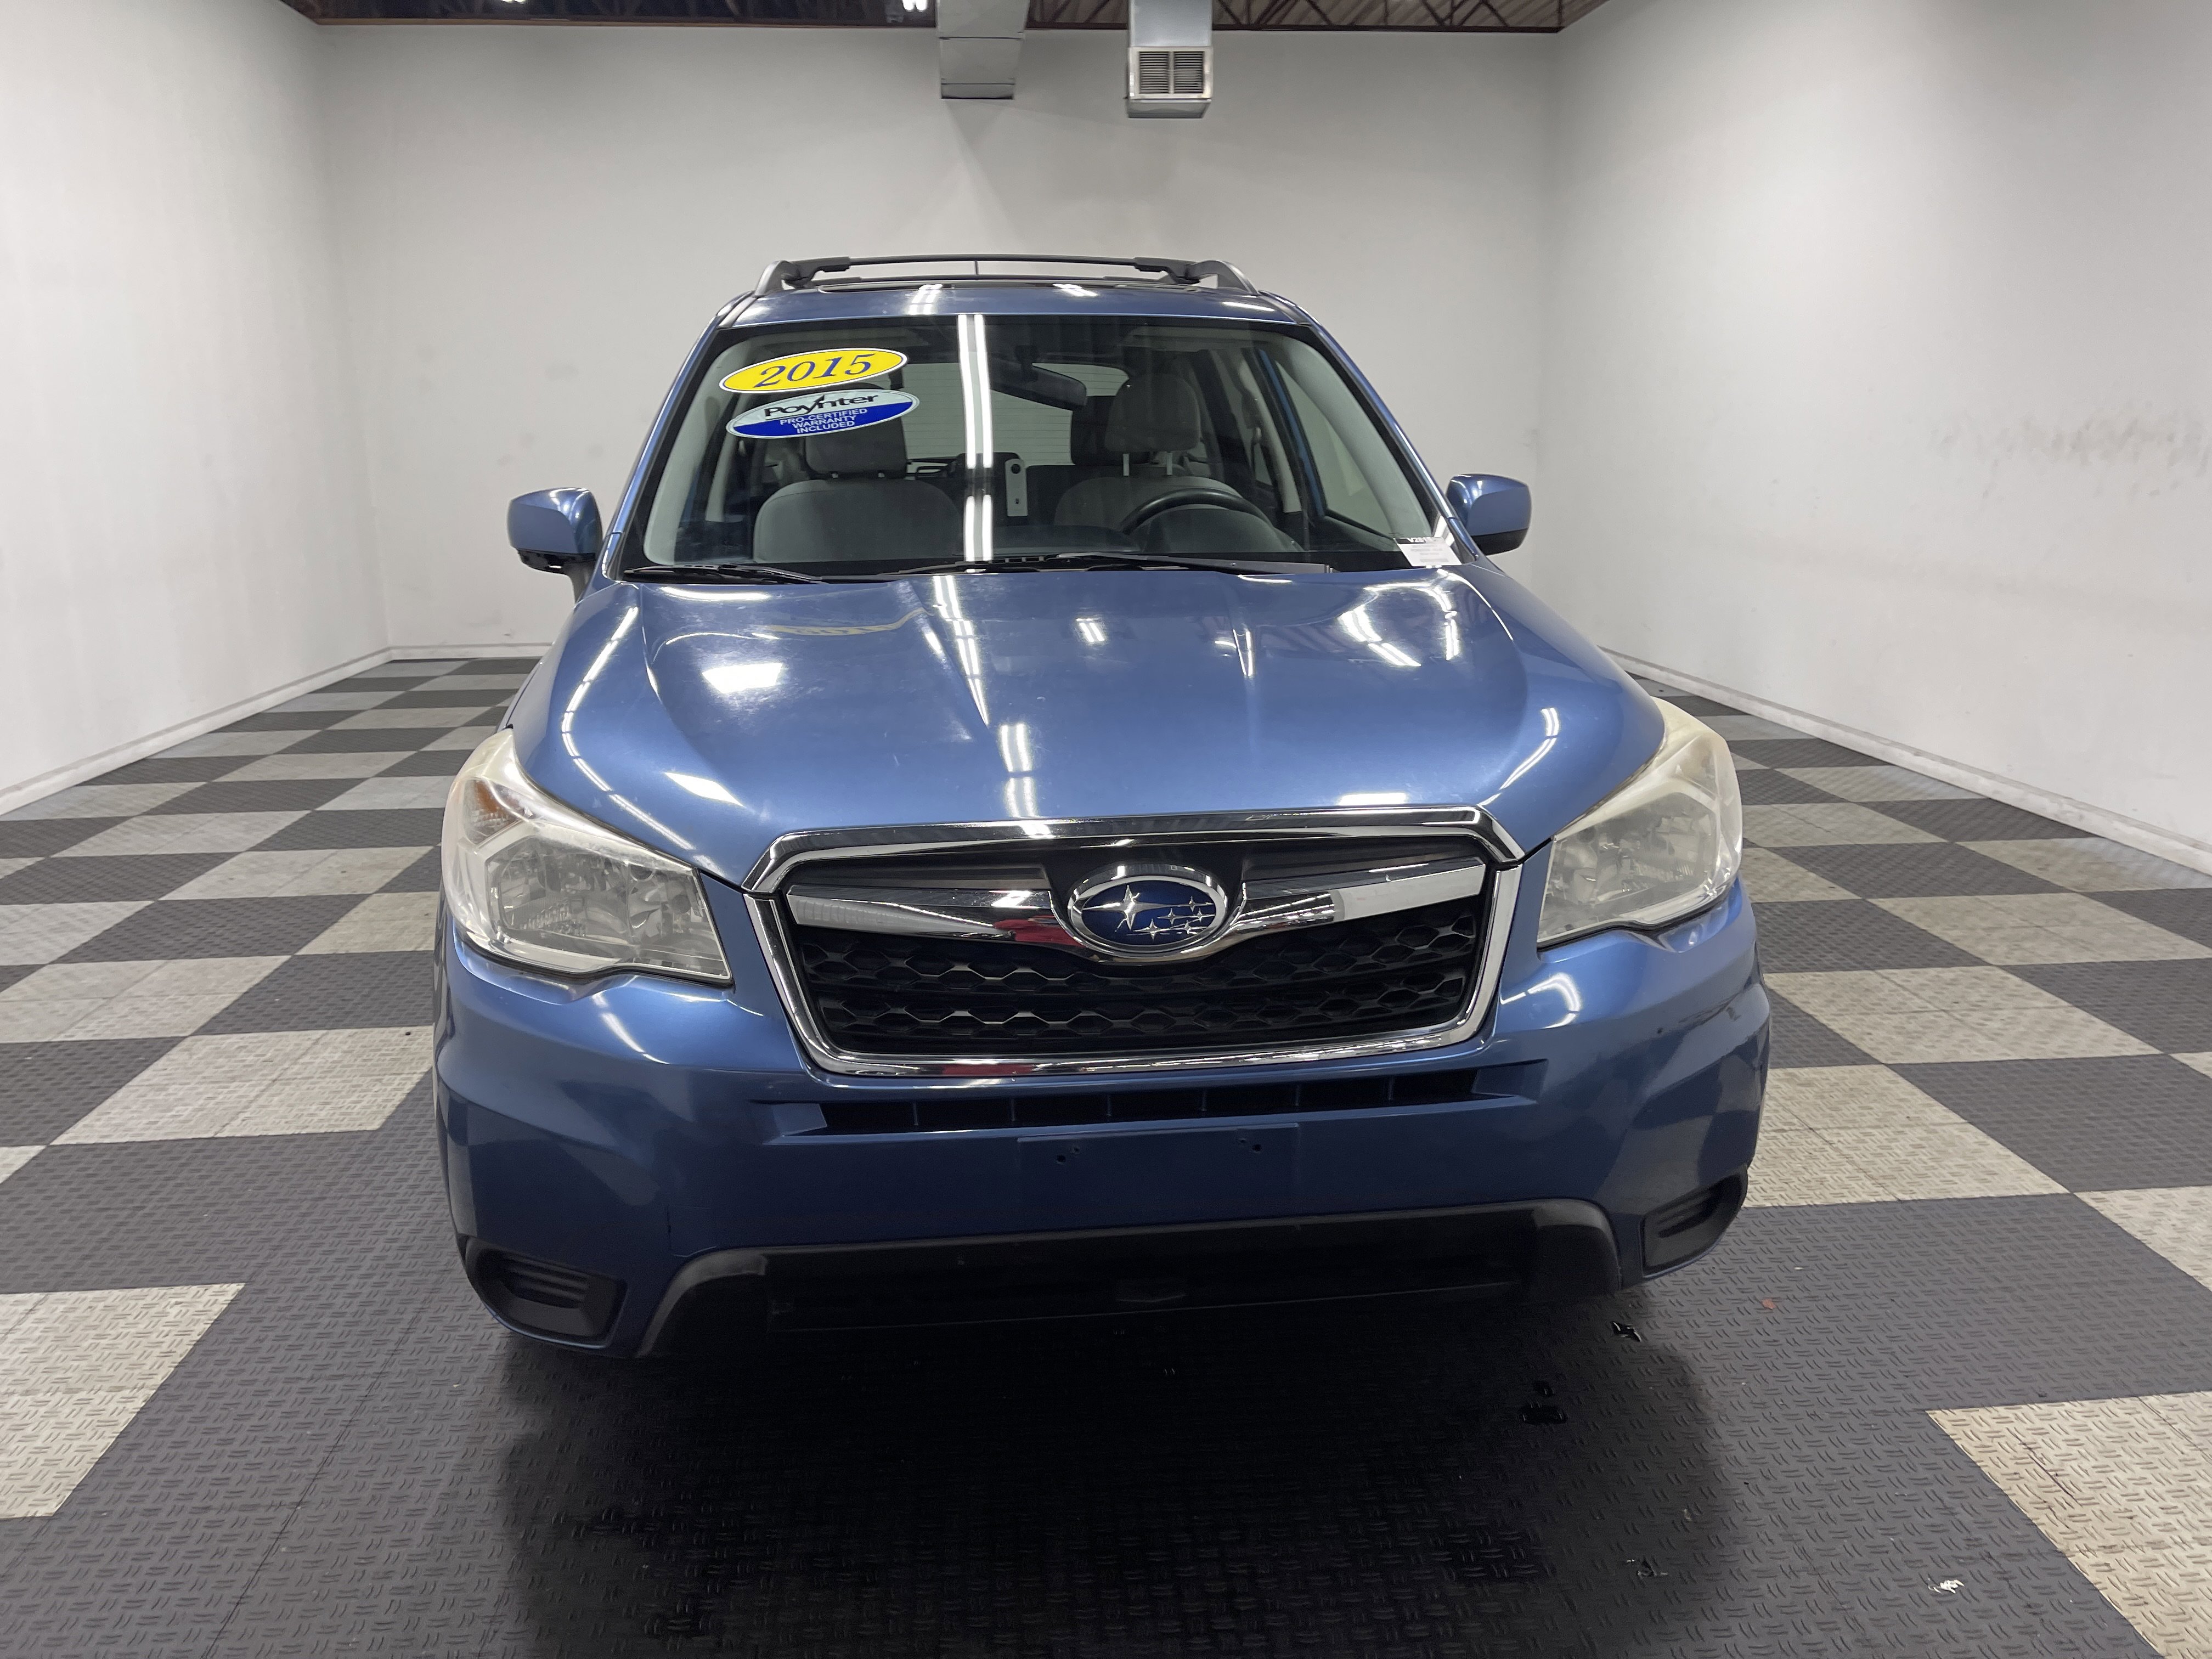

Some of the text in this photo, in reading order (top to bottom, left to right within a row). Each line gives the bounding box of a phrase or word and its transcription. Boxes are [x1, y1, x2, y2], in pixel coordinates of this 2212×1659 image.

[754, 353, 876, 388] 2015
[764, 394, 879, 421] Poynter
[780, 408, 868, 425] PRO-CERTIFIED
[792, 415, 856, 428] WARRANTY
[797, 421, 855, 434] INCLUDED
